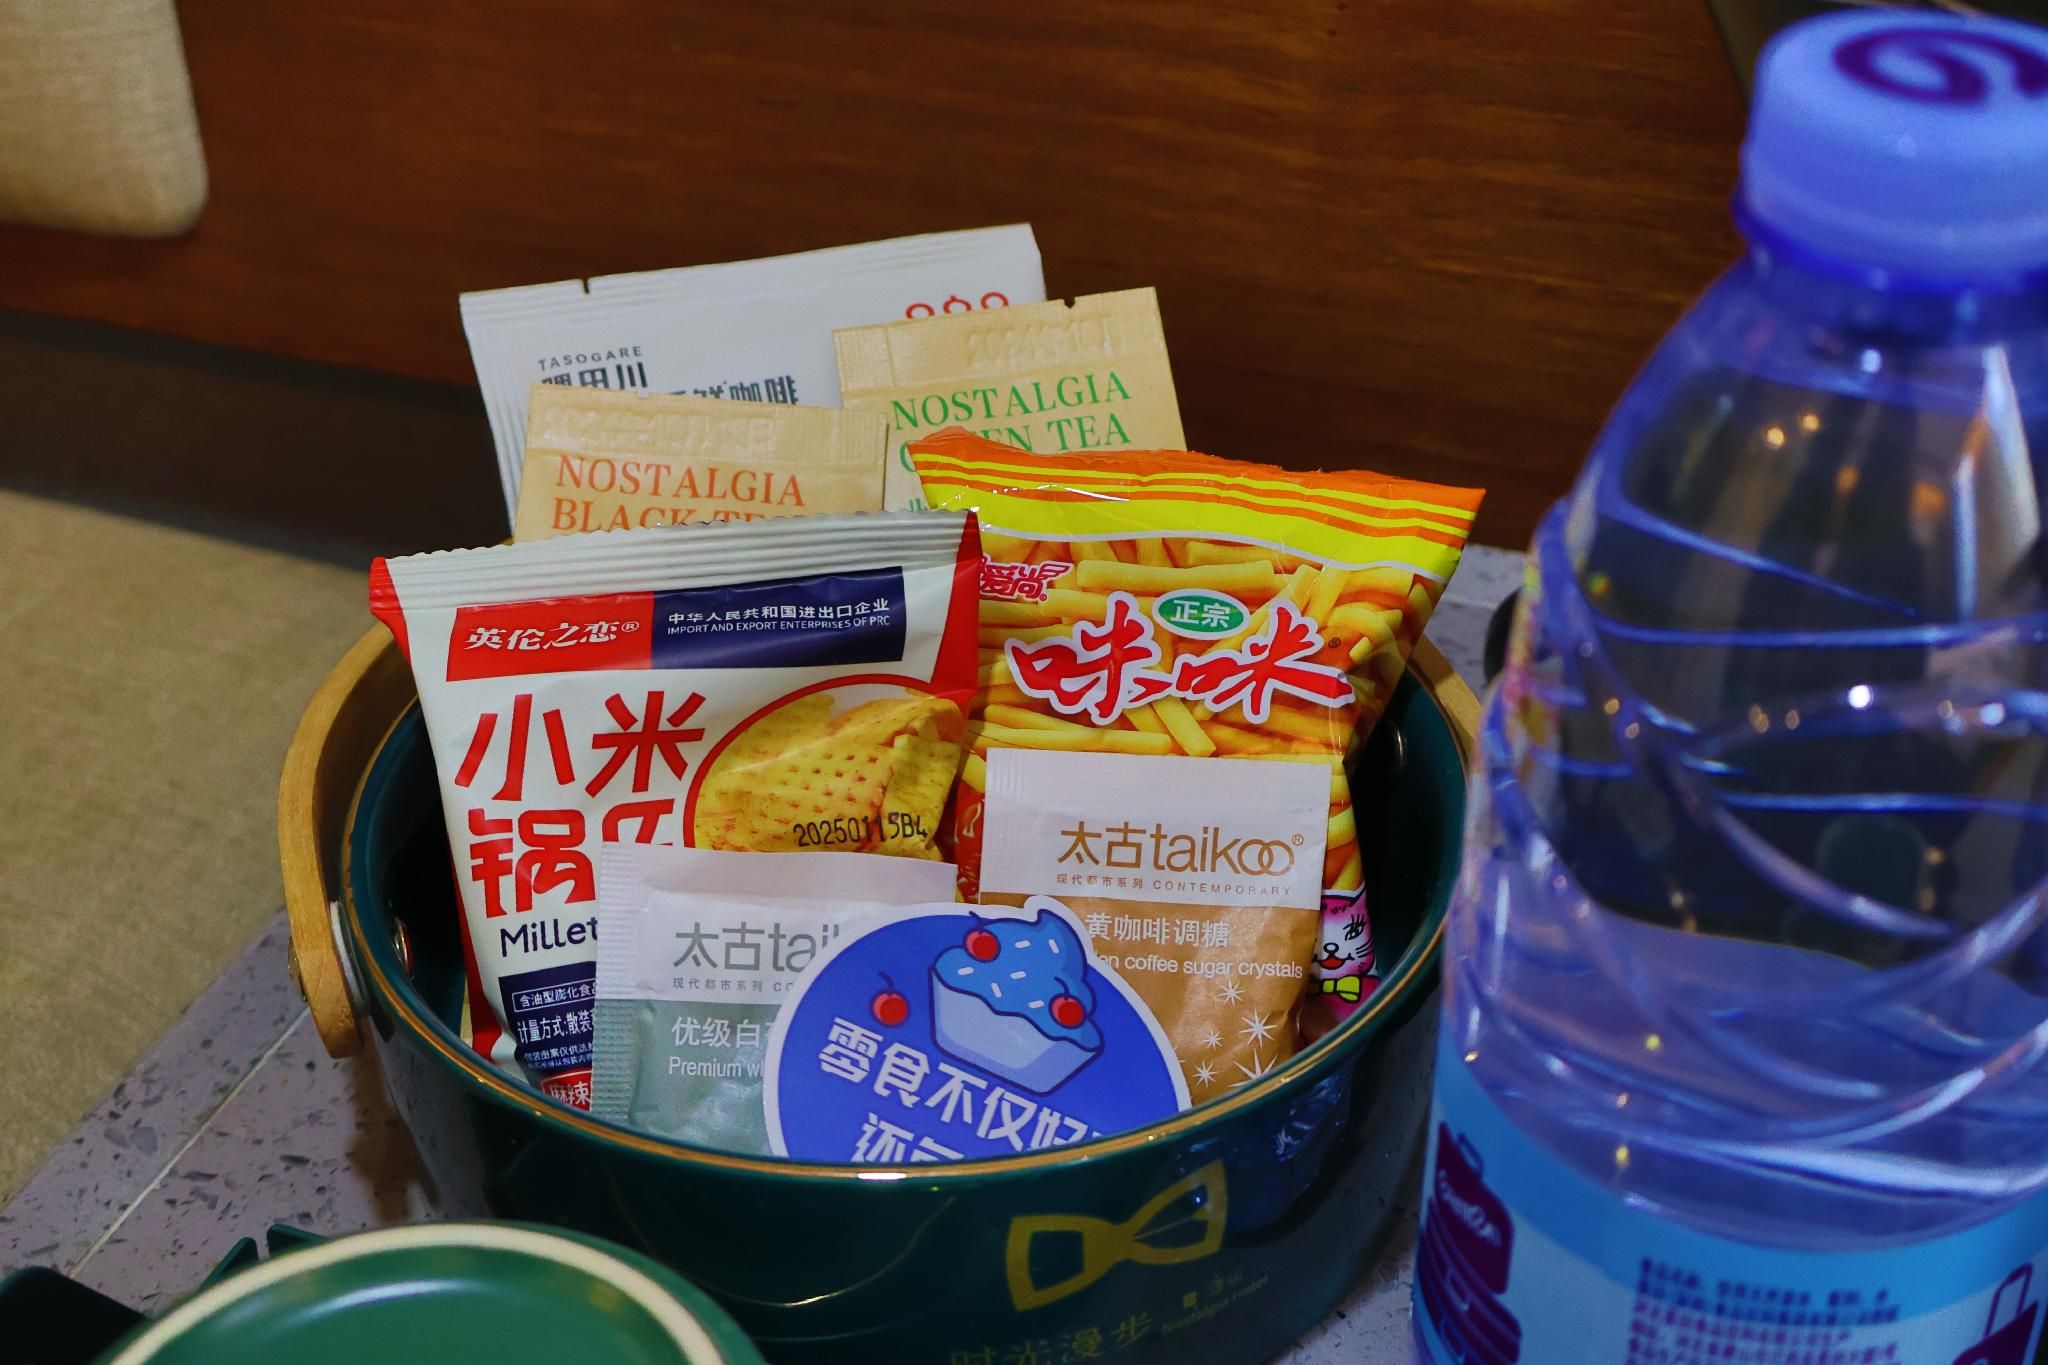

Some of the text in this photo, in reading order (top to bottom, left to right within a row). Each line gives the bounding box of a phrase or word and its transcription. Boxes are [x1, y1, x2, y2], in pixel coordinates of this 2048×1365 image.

[538, 345, 643, 371] TASOGARE
[891, 371, 1131, 431] NOSTALGIA
[1047, 412, 1131, 452] TEA
[556, 453, 805, 507] NOSTALGIA
[667, 615, 891, 635] IMPORT AND EXPORT ENTERPRISES OF PRC
[668, 597, 890, 624] 中华人民共和国进出口企业
[1169, 599, 1231, 629] 正宗
[464, 621, 620, 650] 英伦之恋
[1010, 598, 1354, 719] 咪咪
[454, 690, 706, 802] 小米
[793, 811, 928, 847] 20250115B4
[1057, 820, 1295, 876] 太古taikoo
[1056, 873, 1292, 896] 现代都市系列 CONTEMPORARY
[500, 917, 598, 957] Millet
[1086, 911, 1231, 948] 黄咖啡调糖
[1124, 953, 1179, 973] coffee
[1183, 960, 1232, 979] sugar
[1238, 961, 1303, 979] crystals
[672, 977, 764, 992] 现代都市系列
[671, 1016, 775, 1048] 优级白
[669, 1056, 741, 1077] Premium
[818, 1016, 1103, 1152] 零食不仅好
